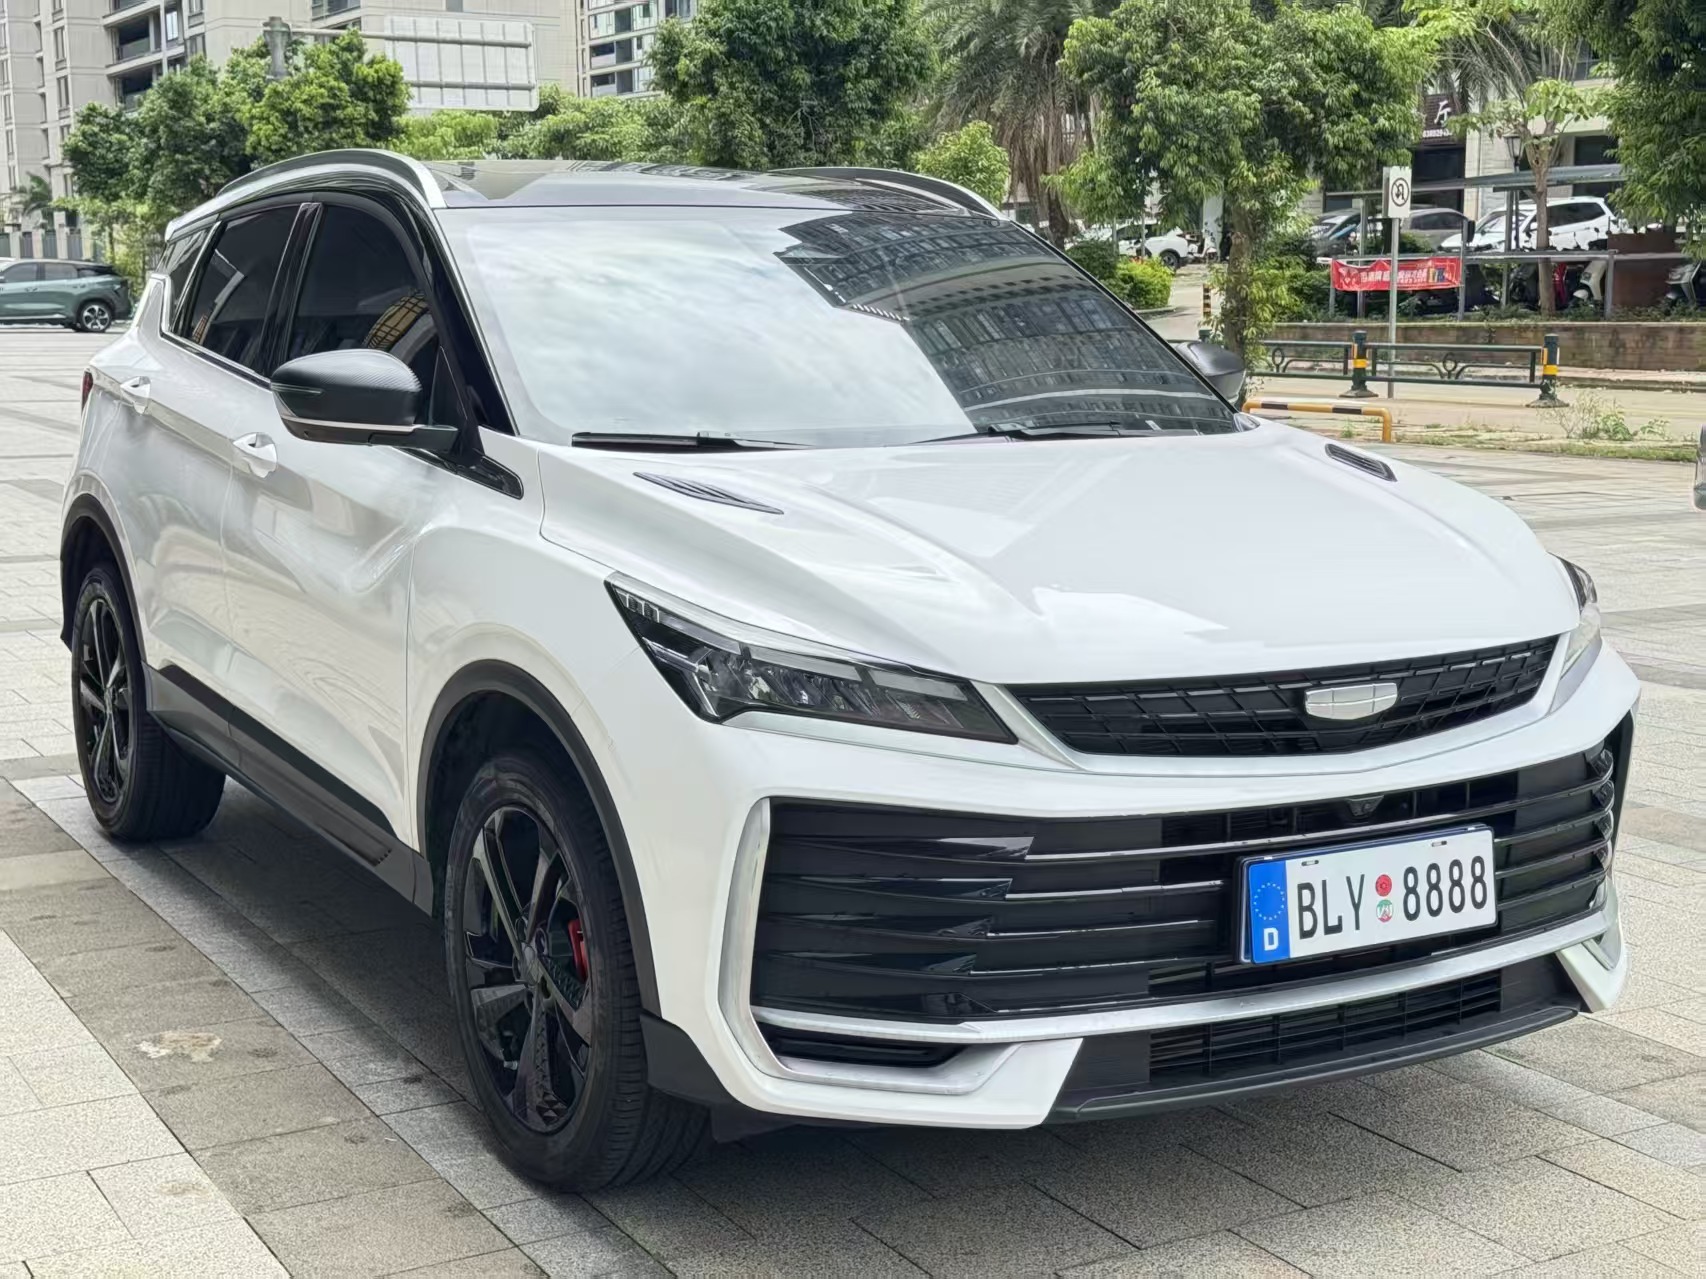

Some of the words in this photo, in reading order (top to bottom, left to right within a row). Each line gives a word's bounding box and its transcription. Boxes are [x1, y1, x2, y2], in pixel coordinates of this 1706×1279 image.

[1297, 874, 1365, 940] BLY
[1403, 855, 1488, 922] 8888
[1263, 927, 1280, 951] D
